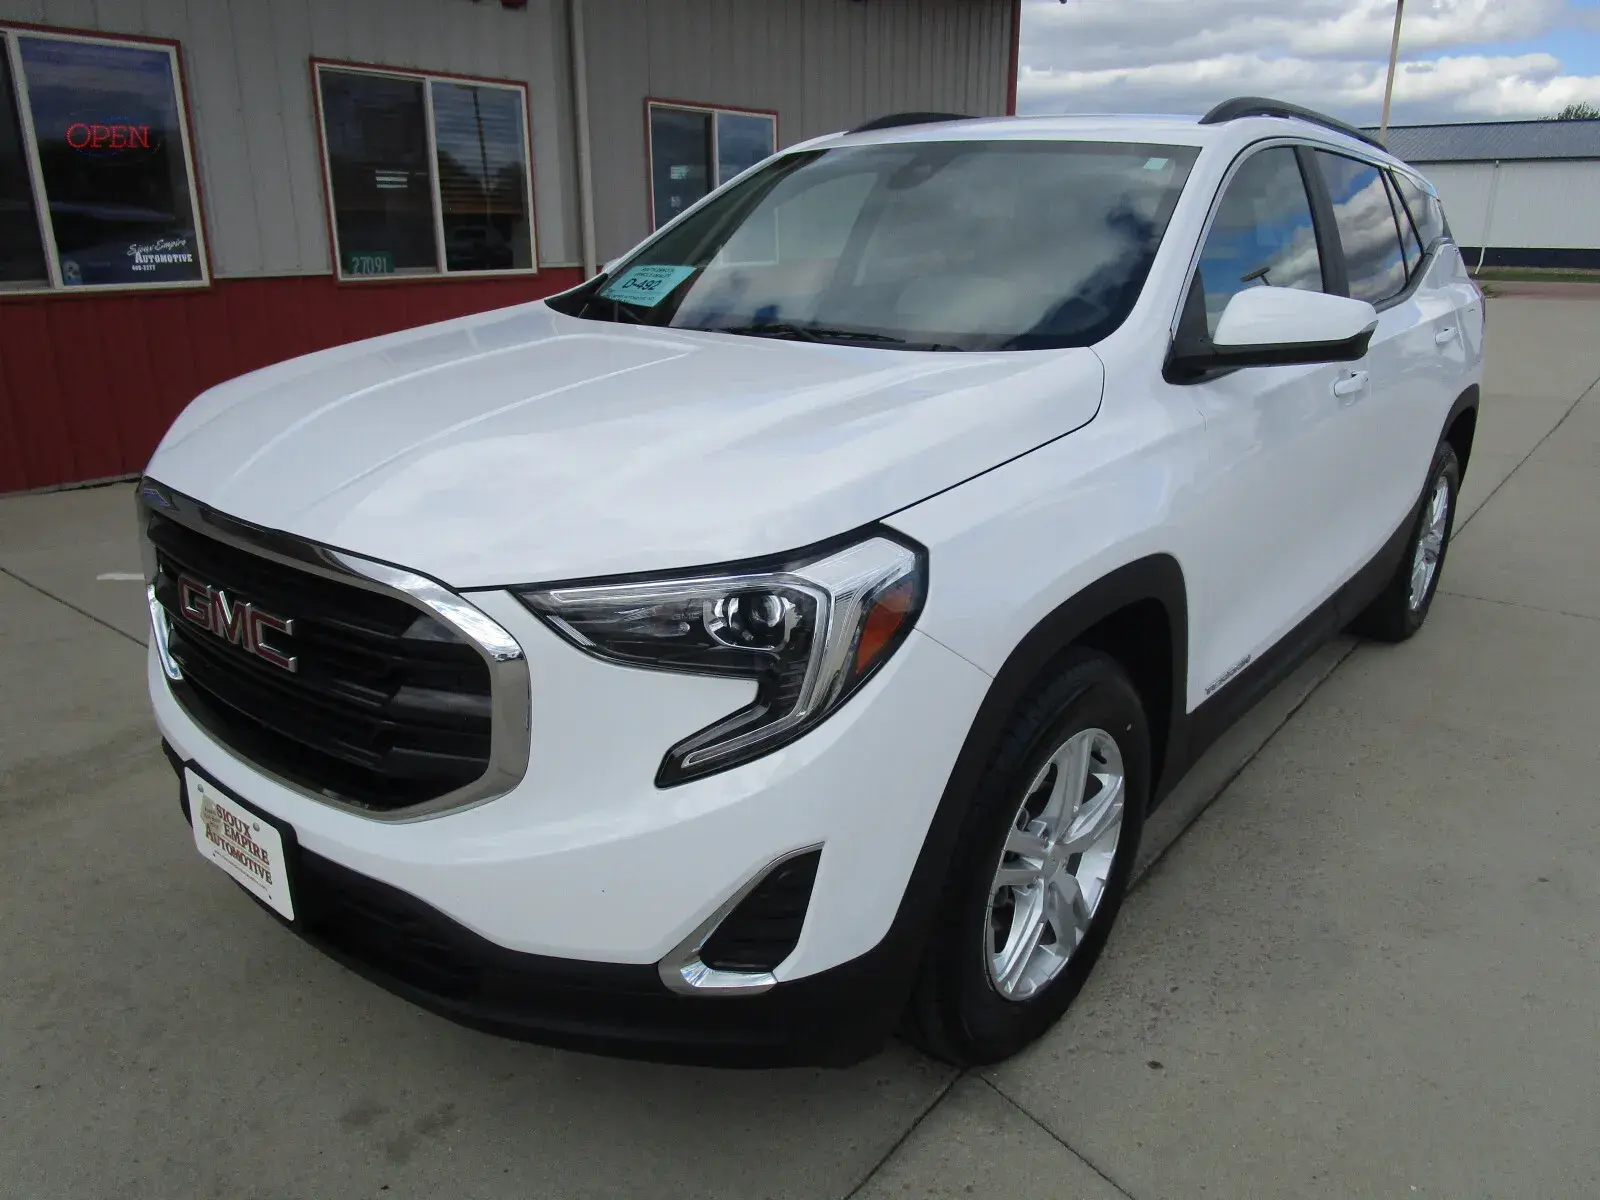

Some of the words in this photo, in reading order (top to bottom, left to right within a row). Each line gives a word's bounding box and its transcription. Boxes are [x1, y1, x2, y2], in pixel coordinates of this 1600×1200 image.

[66, 123, 150, 148] OPEN
[351, 256, 387, 275] 27091
[622, 278, 663, 291] D-492
[178, 572, 297, 673] GMC
[215, 803, 252, 839] SIOUX
[205, 823, 273, 885] AUTOMOTIVE
[223, 822, 270, 866] EMPIRE
